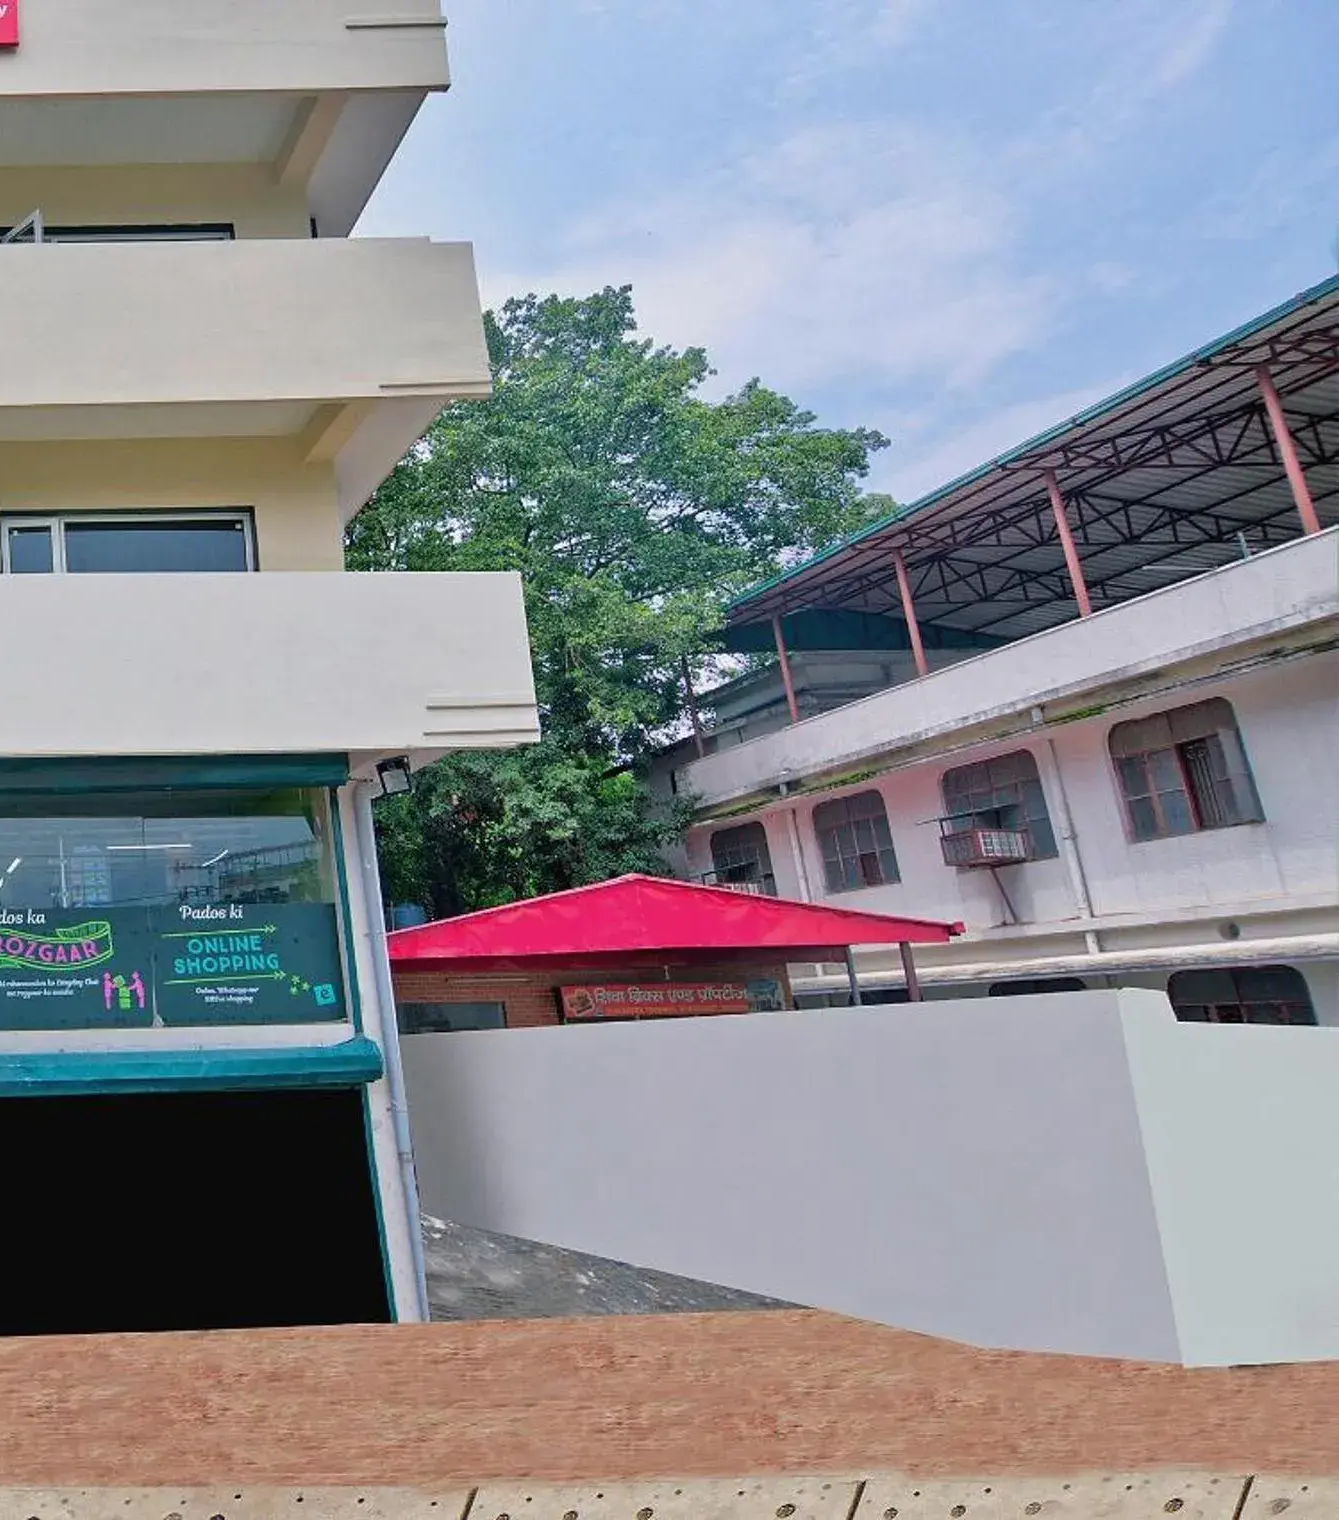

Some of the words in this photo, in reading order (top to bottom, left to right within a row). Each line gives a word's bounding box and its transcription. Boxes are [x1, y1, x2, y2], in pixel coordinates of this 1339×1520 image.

[27, 908, 46, 924] ka
[179, 904, 227, 919] Pados
[229, 903, 244, 919] ki
[188, 935, 262, 954] ONLINE
[174, 953, 279, 974] SHOPPING
